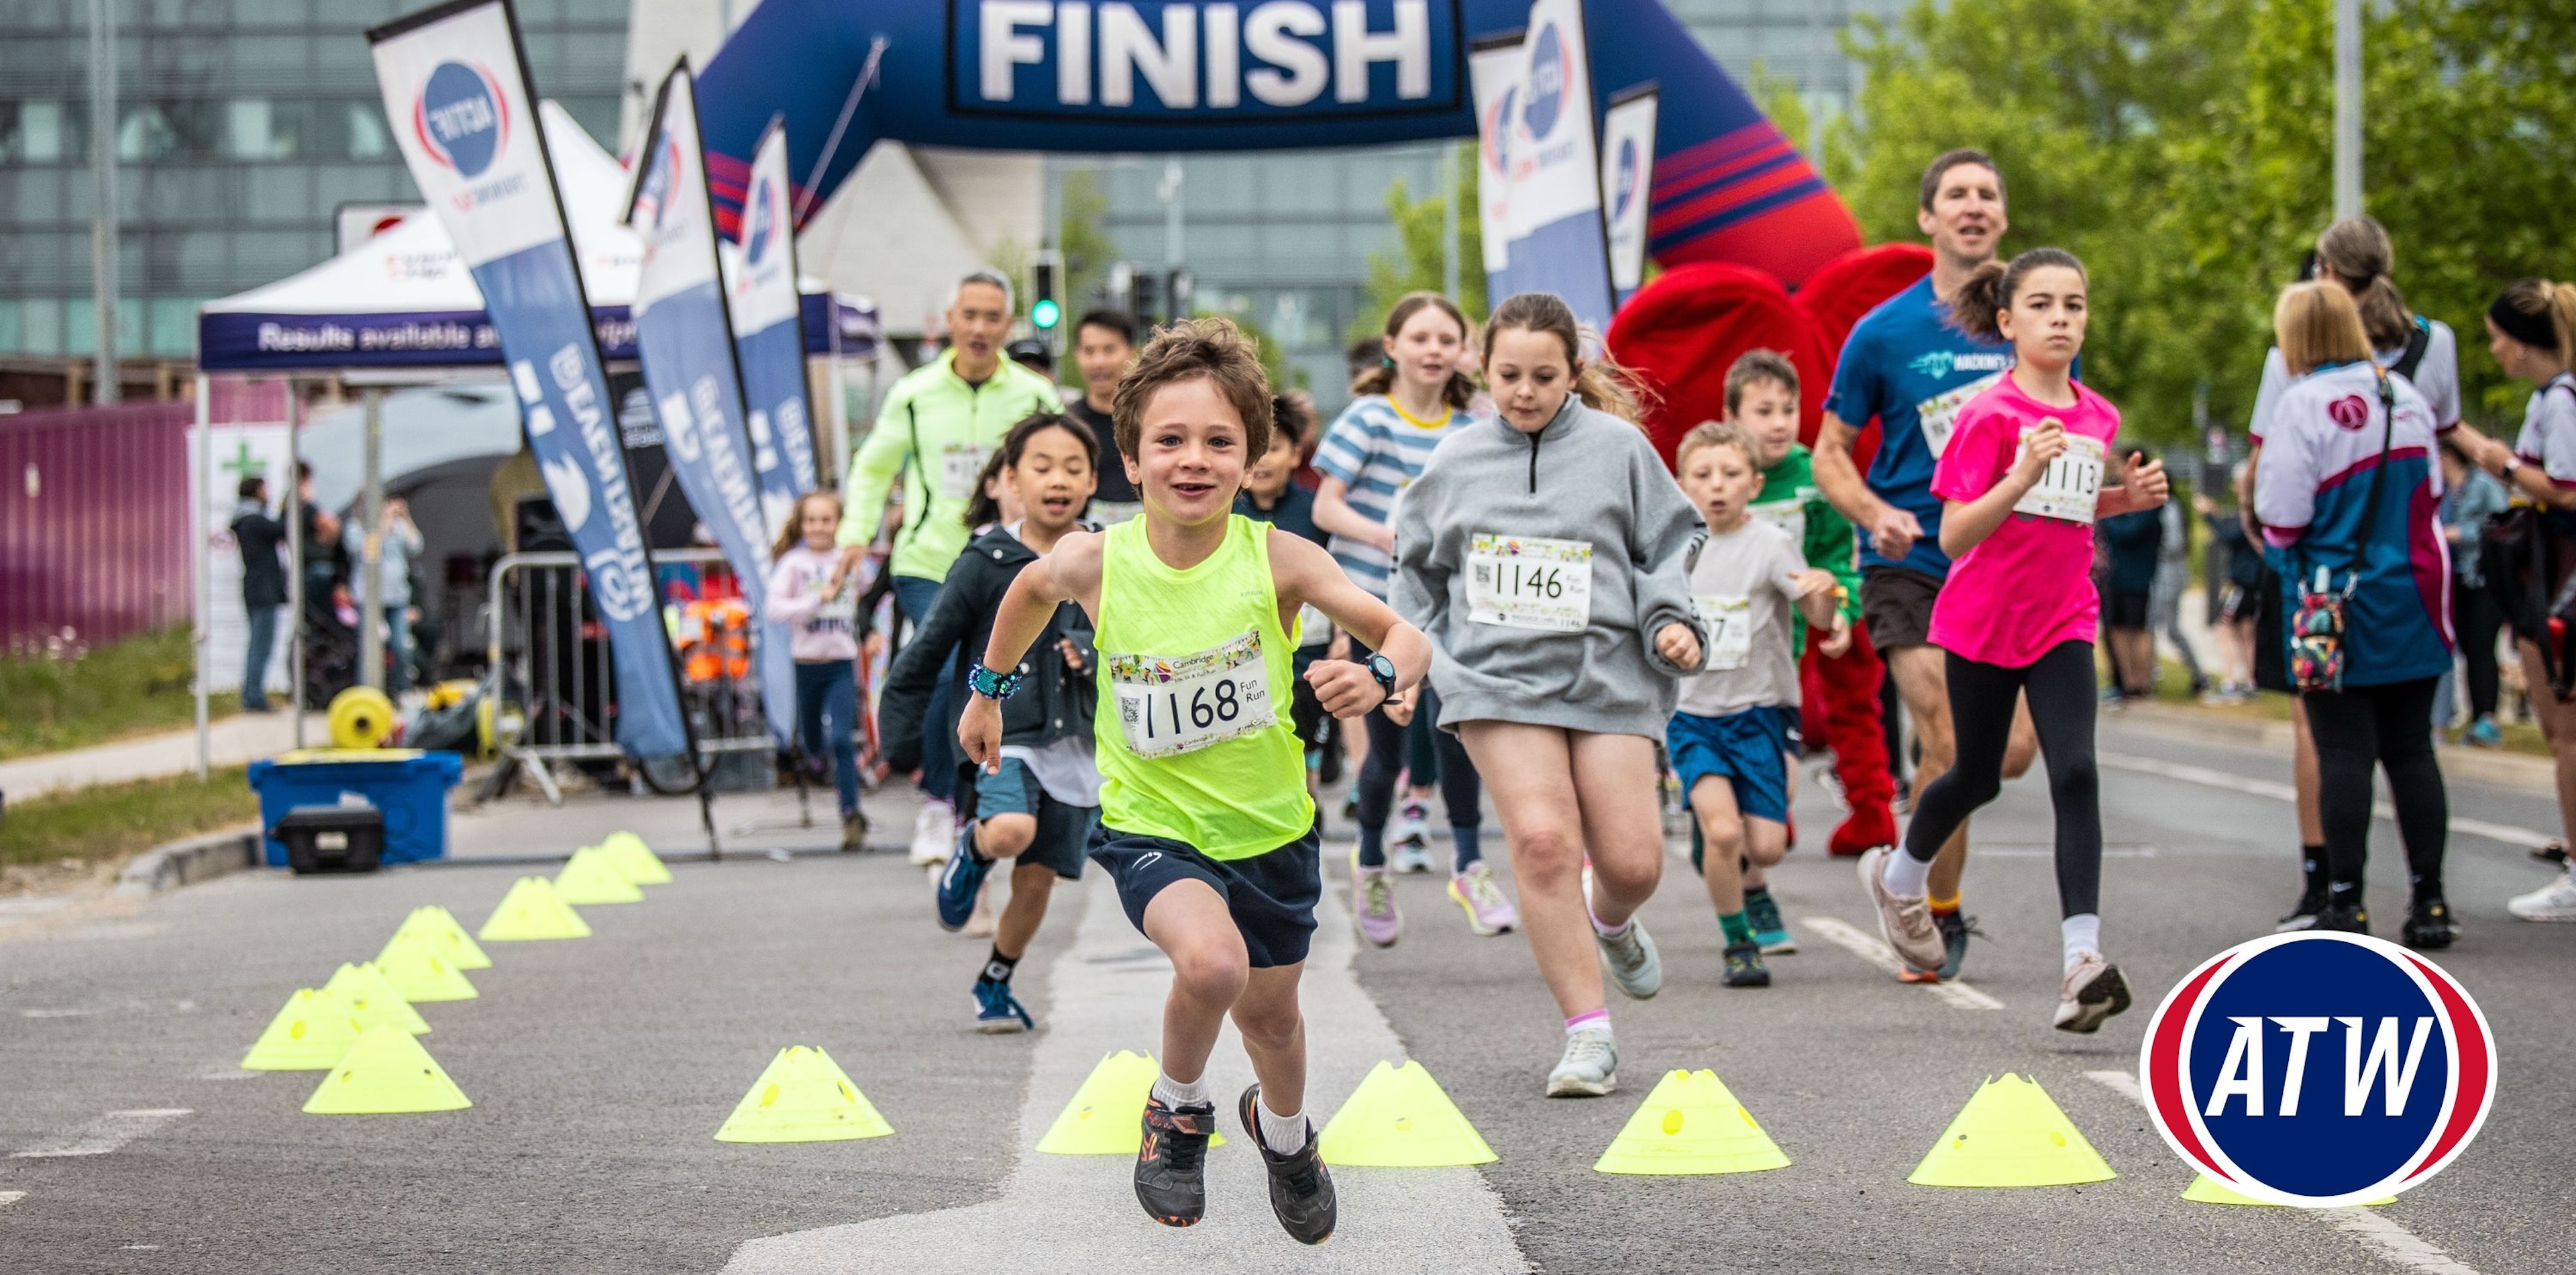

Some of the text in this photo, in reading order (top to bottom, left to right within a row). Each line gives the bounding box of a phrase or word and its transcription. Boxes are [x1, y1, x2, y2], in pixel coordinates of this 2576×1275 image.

[981, 0, 1431, 109] FINISH
[258, 321, 356, 352] Results
[358, 321, 472, 351] available
[1496, 562, 1562, 599] 1146
[1173, 654, 1214, 669] Cambridge
[1240, 678, 1258, 693] Fun
[1246, 688, 1266, 703] Run
[1148, 680, 1238, 738] 1168
